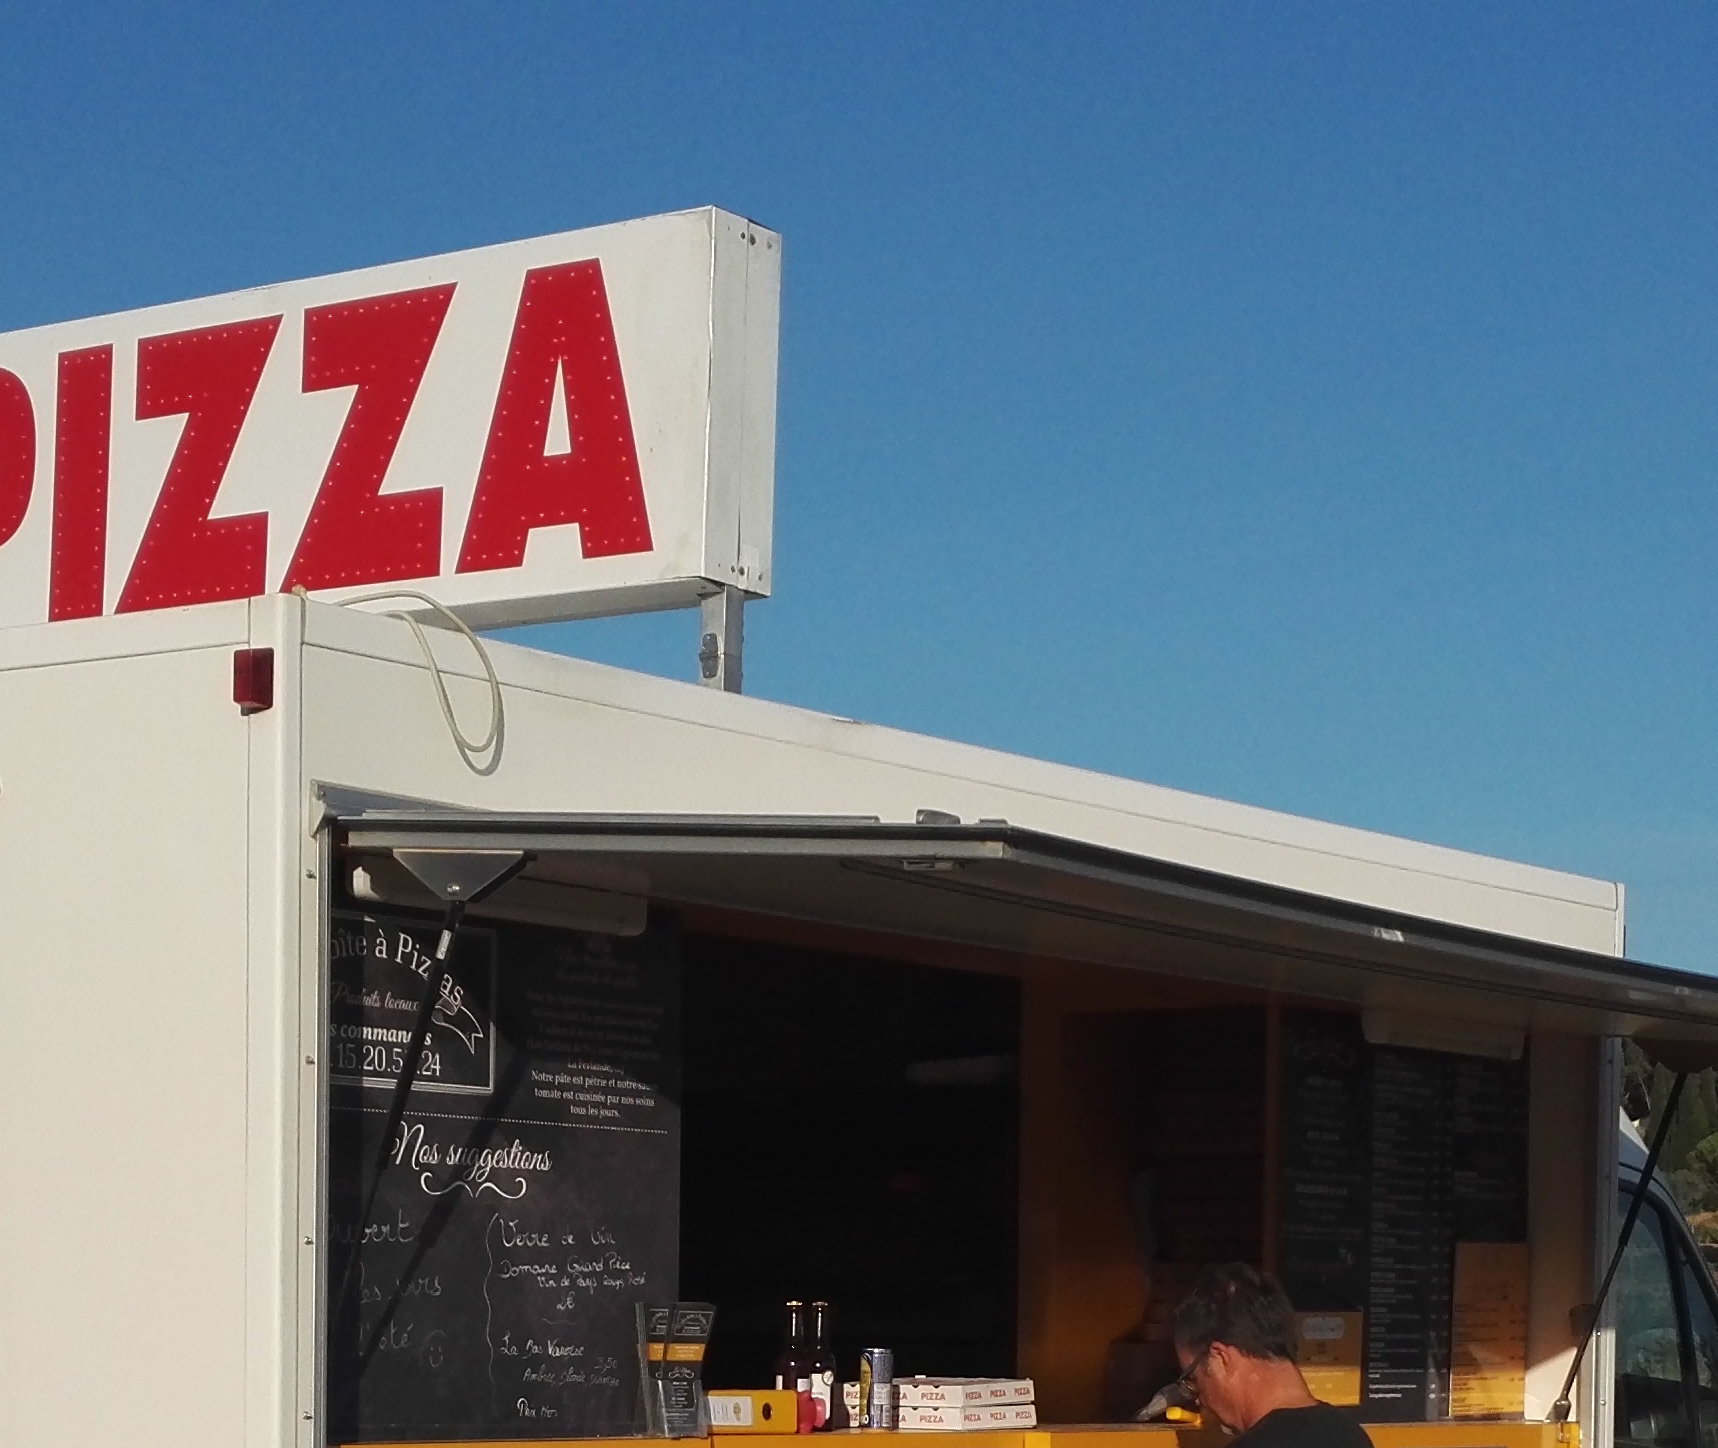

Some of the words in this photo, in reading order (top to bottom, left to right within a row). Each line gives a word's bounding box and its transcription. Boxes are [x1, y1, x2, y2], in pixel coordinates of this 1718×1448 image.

[394, 931, 465, 1006] Pizas
[532, 1070, 553, 1082] Notre
[555, 1072, 571, 1085] pâte
[573, 1076, 583, 1085] est
[608, 1078, 615, 1088] et
[617, 1080, 636, 1090] notre
[534, 1088, 561, 1099] tomate
[563, 1090, 574, 1100] est
[607, 1095, 620, 1106] par
[621, 1096, 634, 1105] nos
[635, 1097, 654, 1107] soins
[570, 1105, 586, 1116] tous
[588, 1105, 598, 1116] les
[391, 1121, 440, 1171] Nos
[446, 1139, 553, 1182] suggestions
[499, 1218, 550, 1247] Verre
[920, 1392, 946, 1400] PIZZA
[919, 1414, 944, 1423] PIZZA
